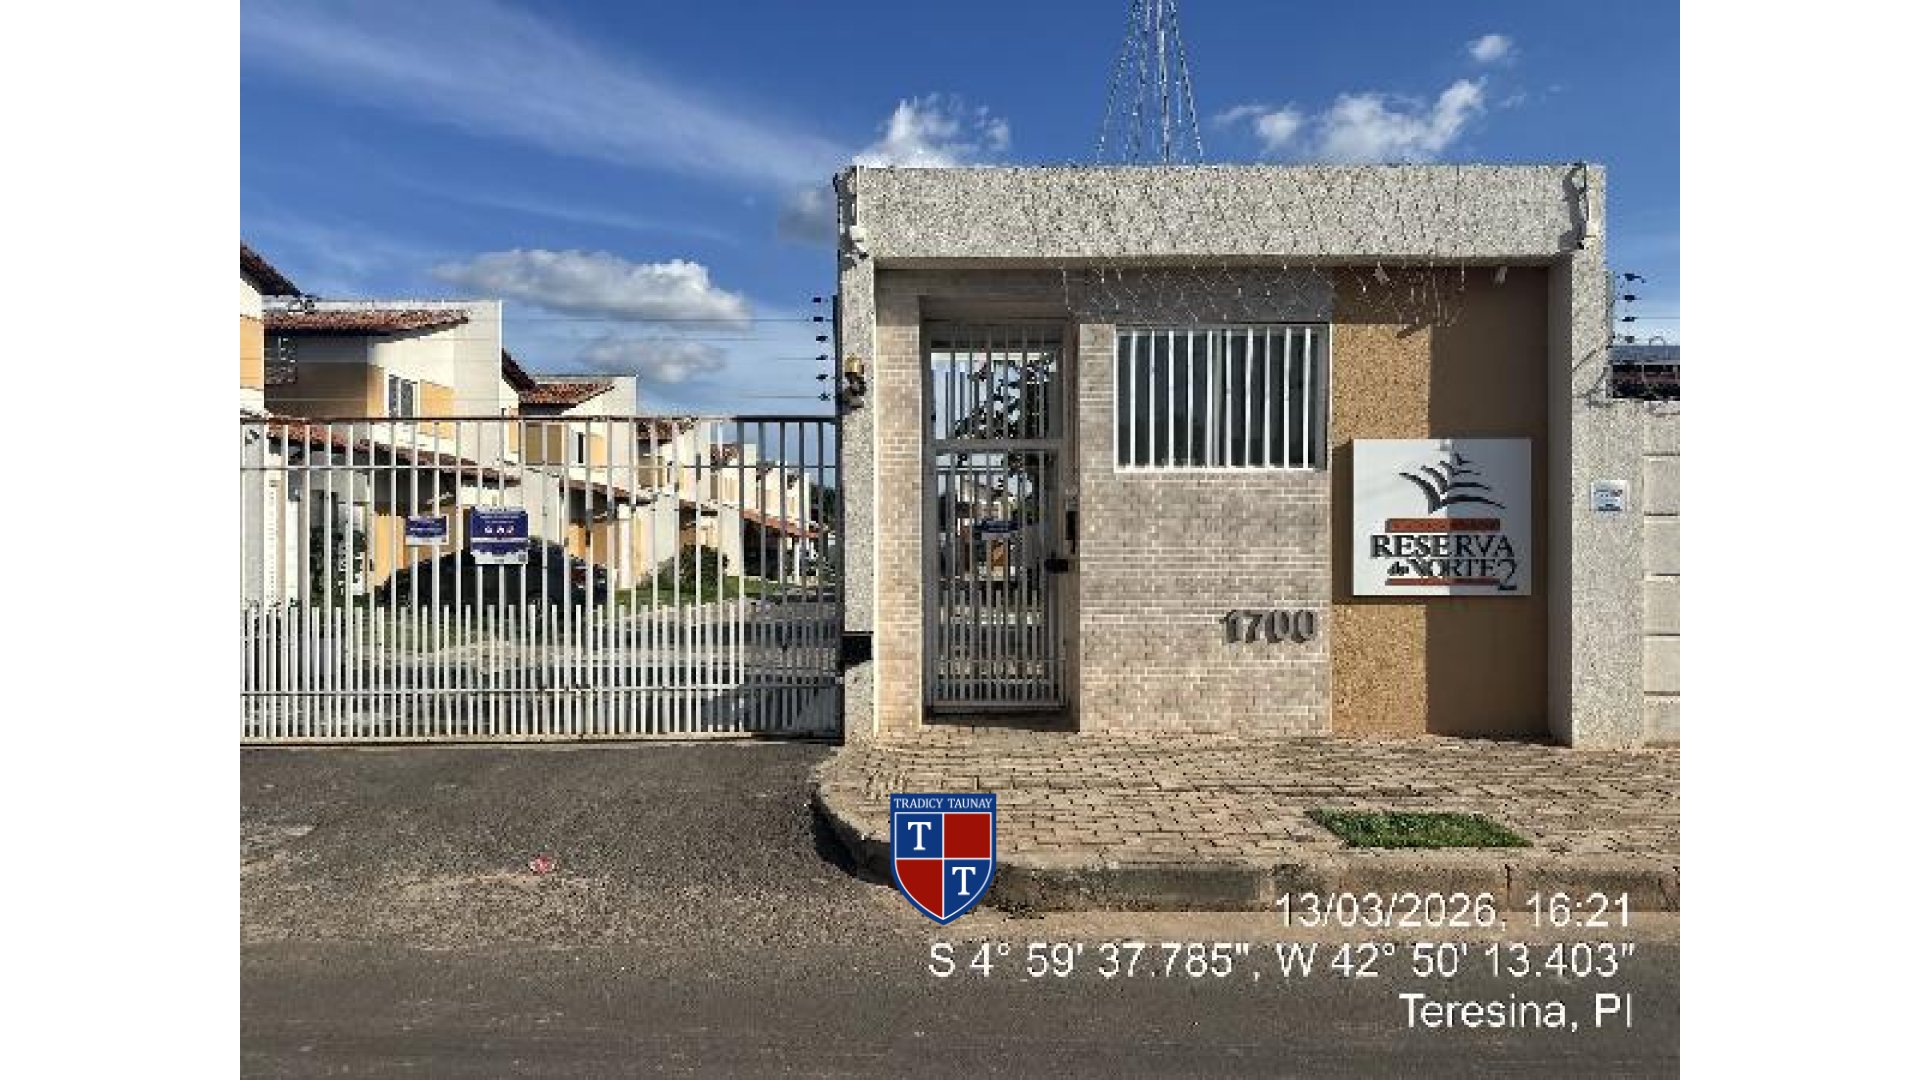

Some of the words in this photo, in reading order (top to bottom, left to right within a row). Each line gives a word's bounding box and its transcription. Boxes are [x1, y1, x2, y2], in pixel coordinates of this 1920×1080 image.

[1370, 534, 1515, 557] RESERVA
[1407, 558, 1496, 577] NORTE
[1497, 558, 1518, 591] 2
[1219, 609, 1317, 644] 1700
